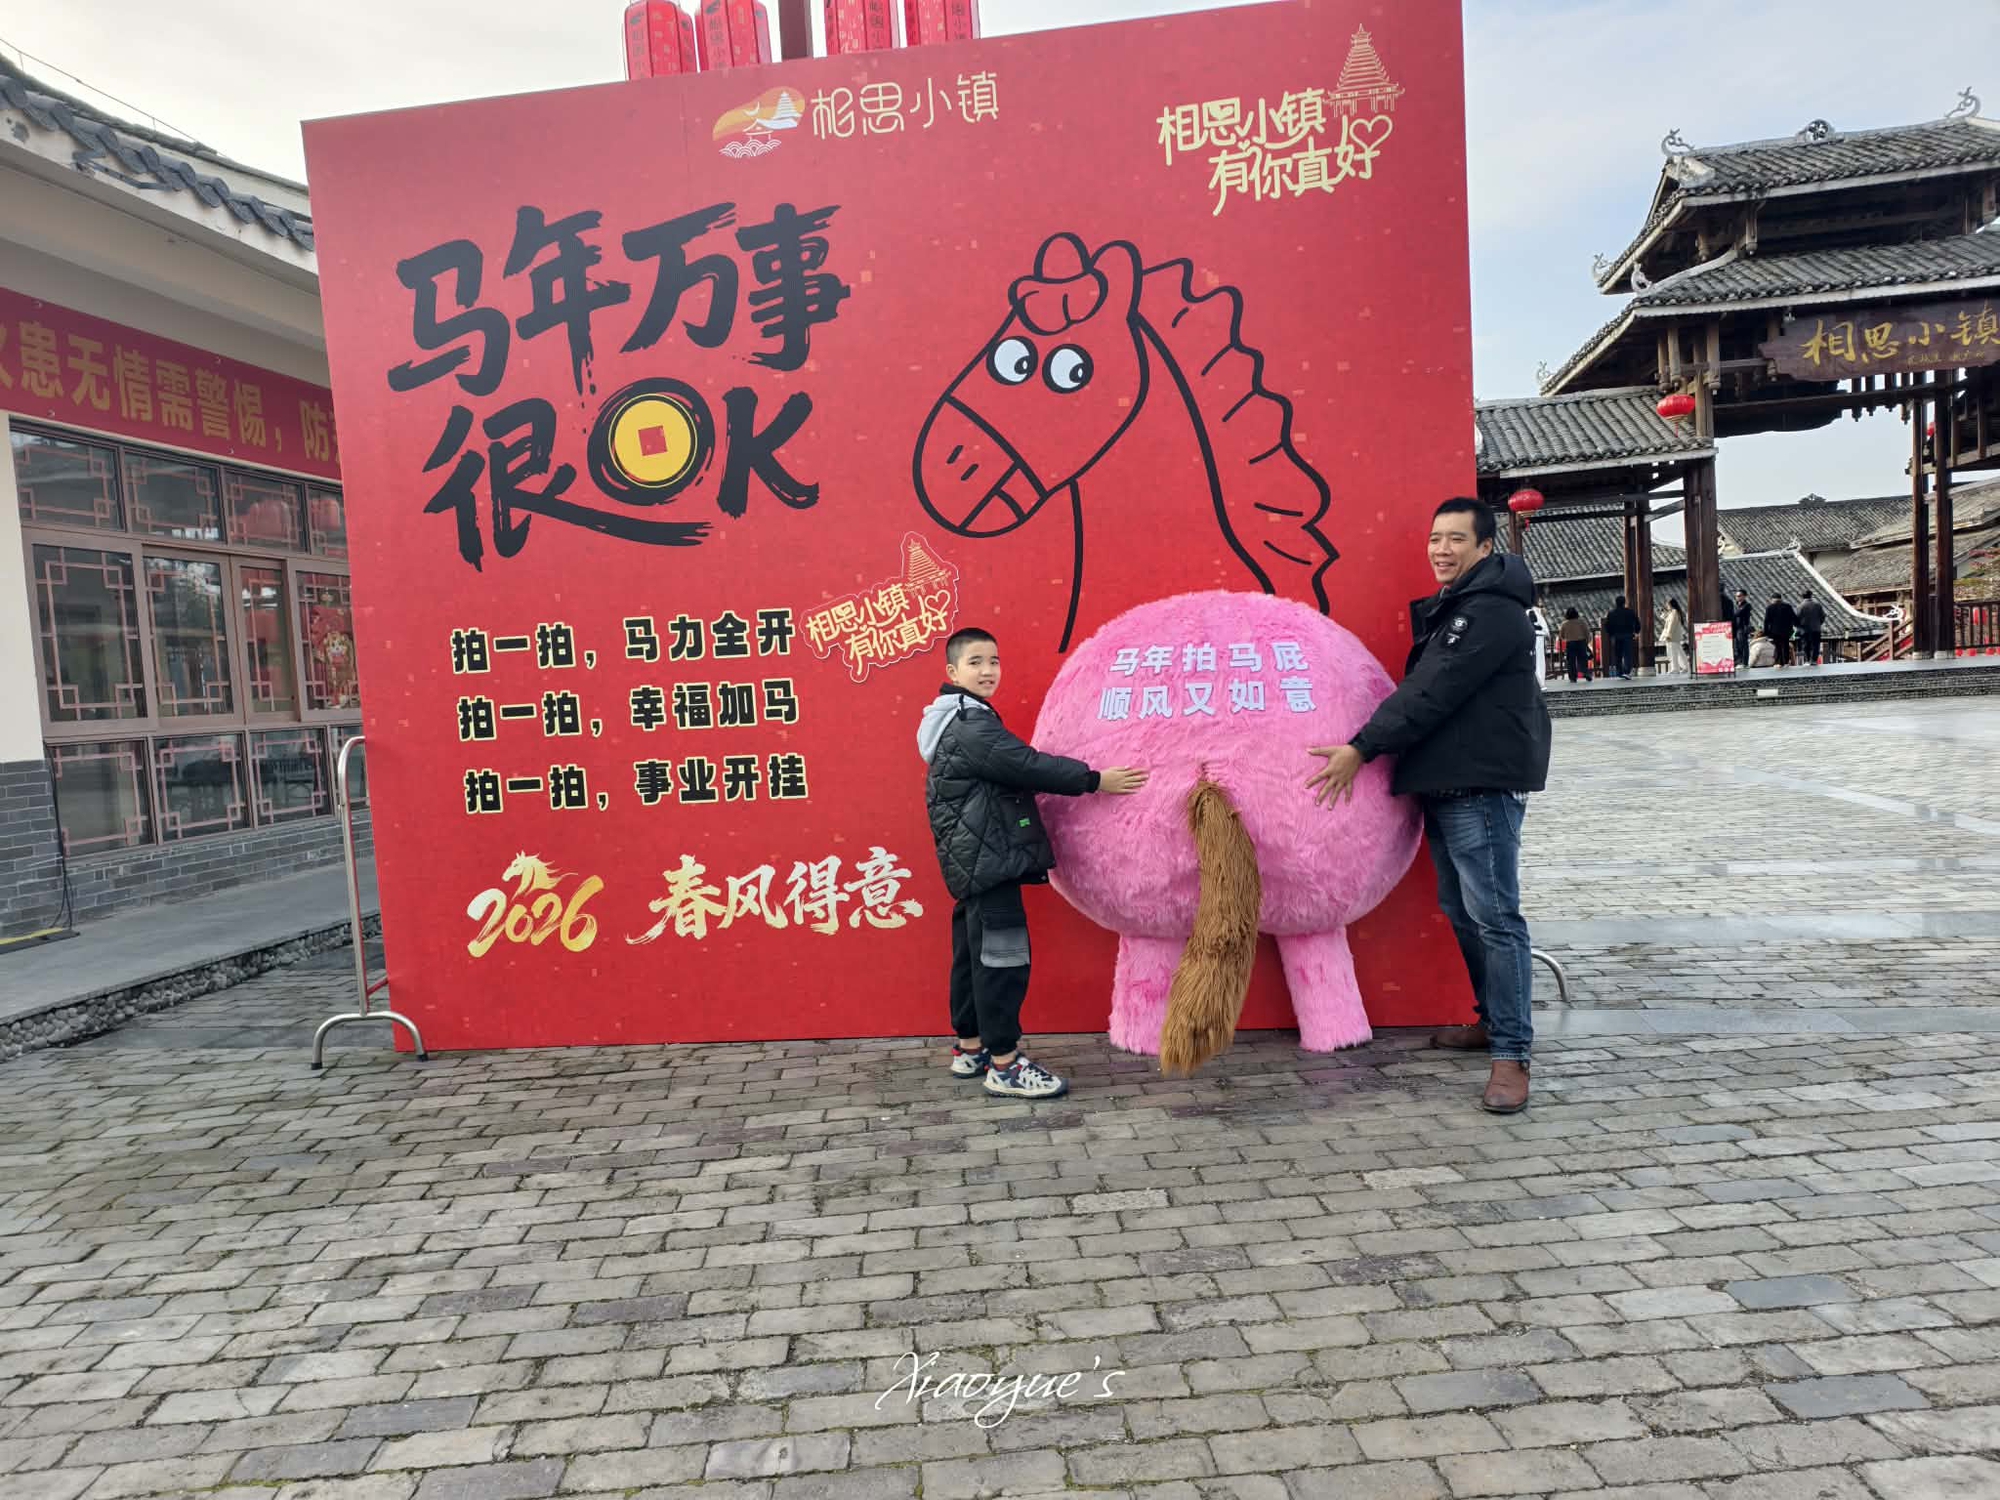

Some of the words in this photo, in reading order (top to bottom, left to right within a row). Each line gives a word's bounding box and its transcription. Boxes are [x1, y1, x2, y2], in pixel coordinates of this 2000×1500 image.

[811, 71, 998, 139] 相思小镇
[1156, 87, 1327, 166] 相思小镇
[1208, 115, 1393, 217] 有你真好
[388, 202, 851, 396] 马年万事
[1801, 299, 2000, 367] 相思小镇
[806, 584, 910, 653] 相思小镇
[845, 590, 951, 676] 有你真好
[1097, 675, 1316, 721] 顺风又如意
[1109, 641, 1310, 678] 马年拍马屁
[467, 875, 605, 957] 2026
[625, 846, 924, 945] 春风得意
